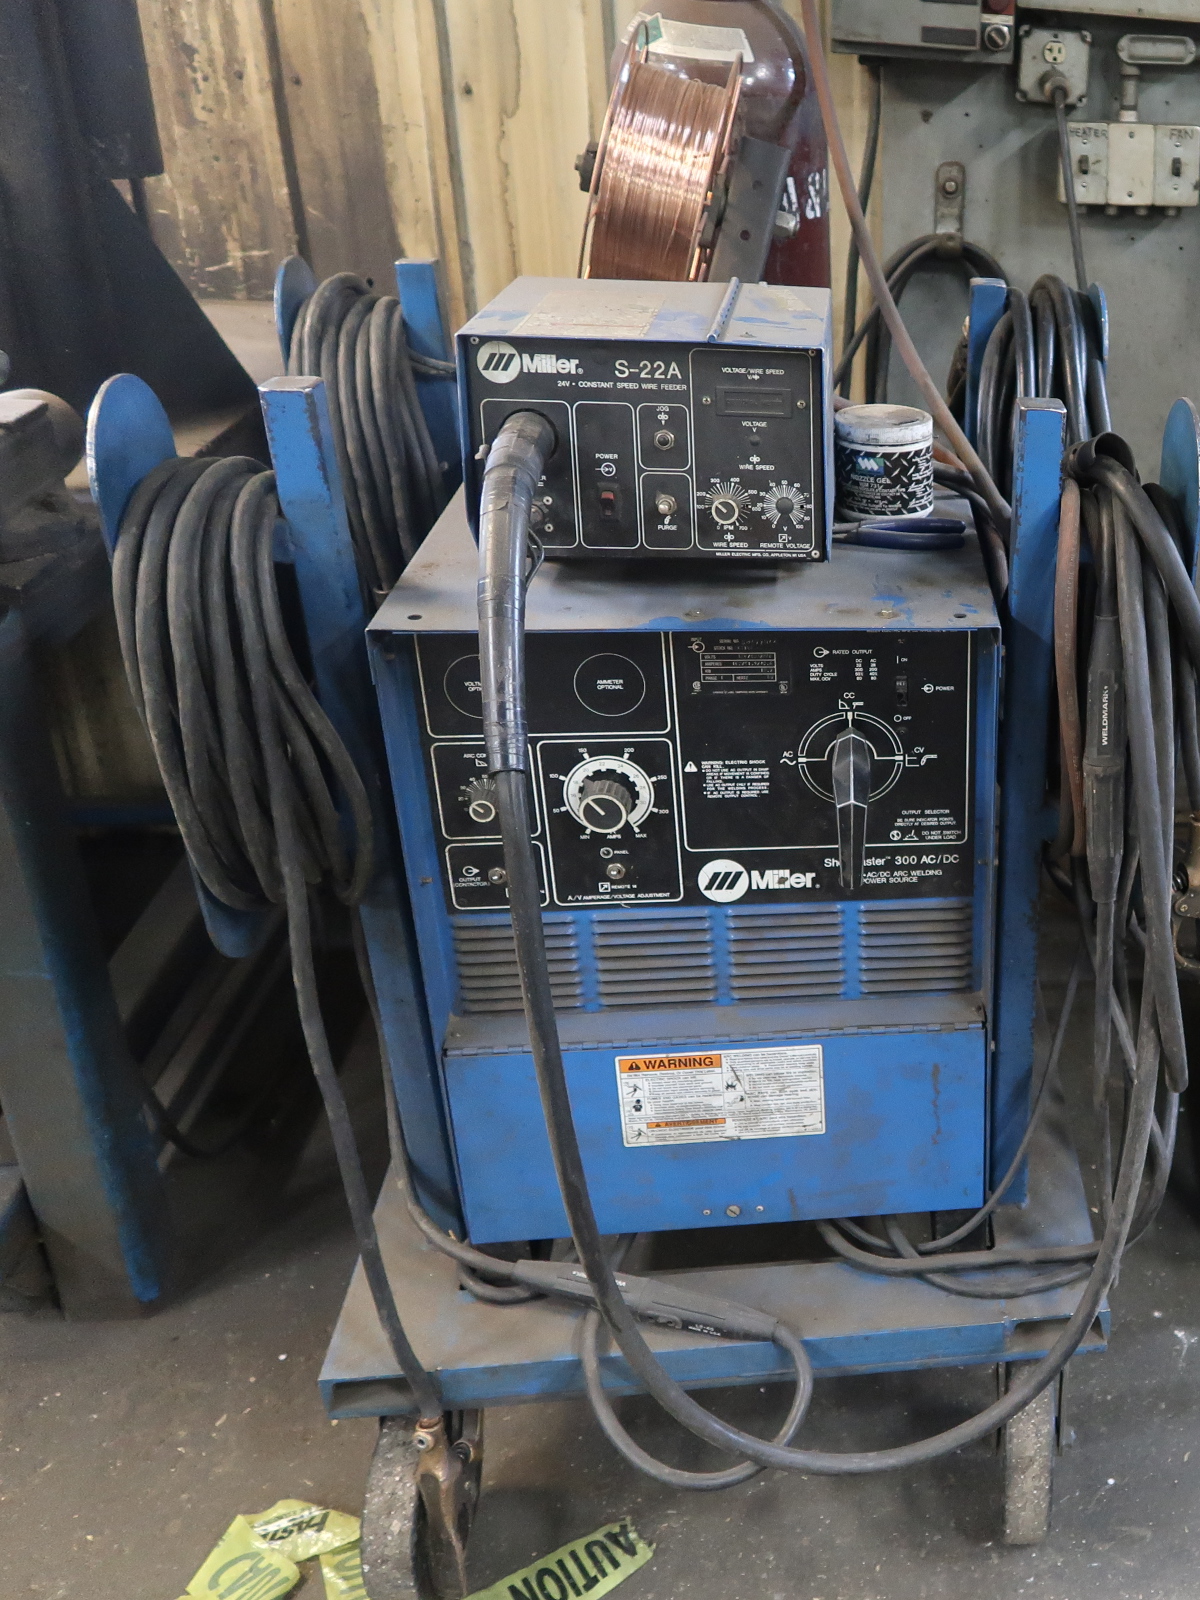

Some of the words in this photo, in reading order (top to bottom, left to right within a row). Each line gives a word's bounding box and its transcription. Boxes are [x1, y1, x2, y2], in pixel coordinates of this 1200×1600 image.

[1069, 127, 1108, 139] HEATER
[1169, 128, 1194, 140] FAN
[522, 353, 580, 374] Miller
[614, 359, 682, 379] S-22A
[1101, 690, 1109, 746] WELDMARK
[895, 856, 917, 865] 300
[920, 854, 959, 864] AC/DC
[643, 1056, 714, 1070] WARNING
